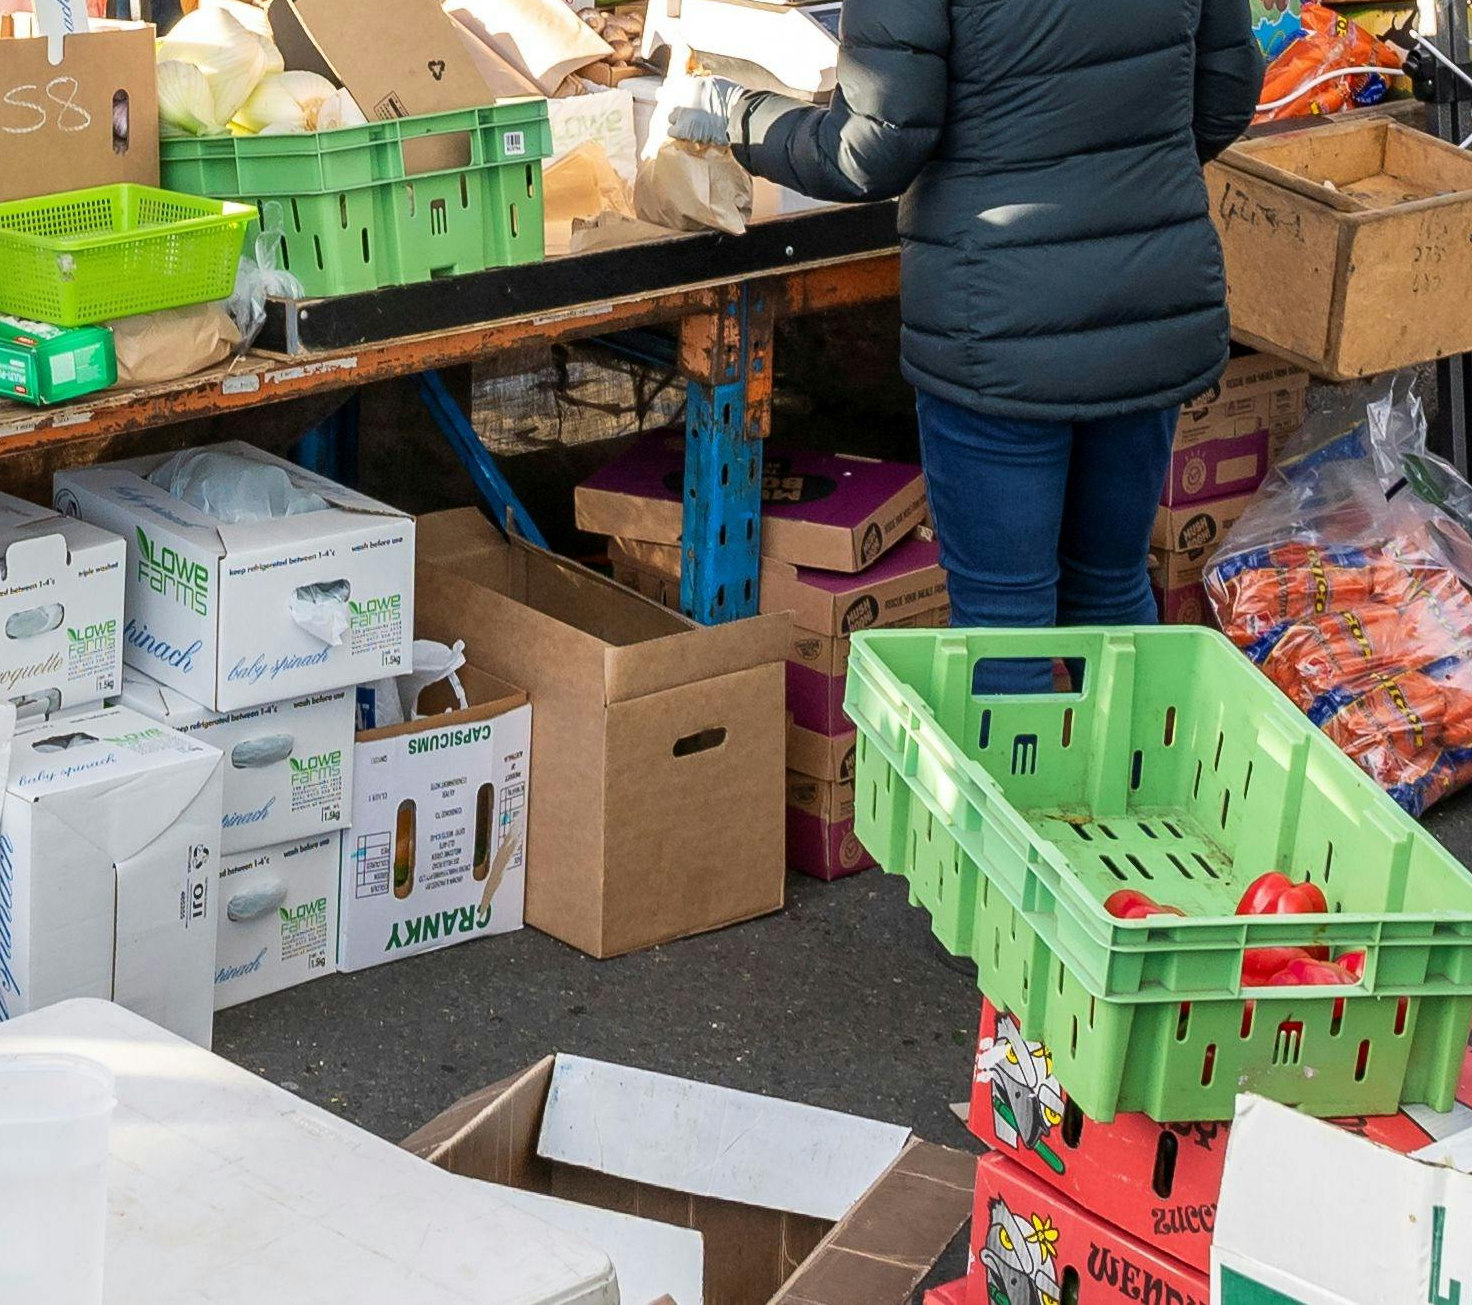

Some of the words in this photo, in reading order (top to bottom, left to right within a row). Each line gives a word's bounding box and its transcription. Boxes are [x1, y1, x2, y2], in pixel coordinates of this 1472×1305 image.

[228, 656, 267, 685] baby
[270, 645, 331, 680] spinach
[408, 725, 491, 754] CAPSICUMS
[60, 753, 117, 777] spinach
[192, 883, 205, 918] OJI
[385, 904, 492, 951] CRANKY
